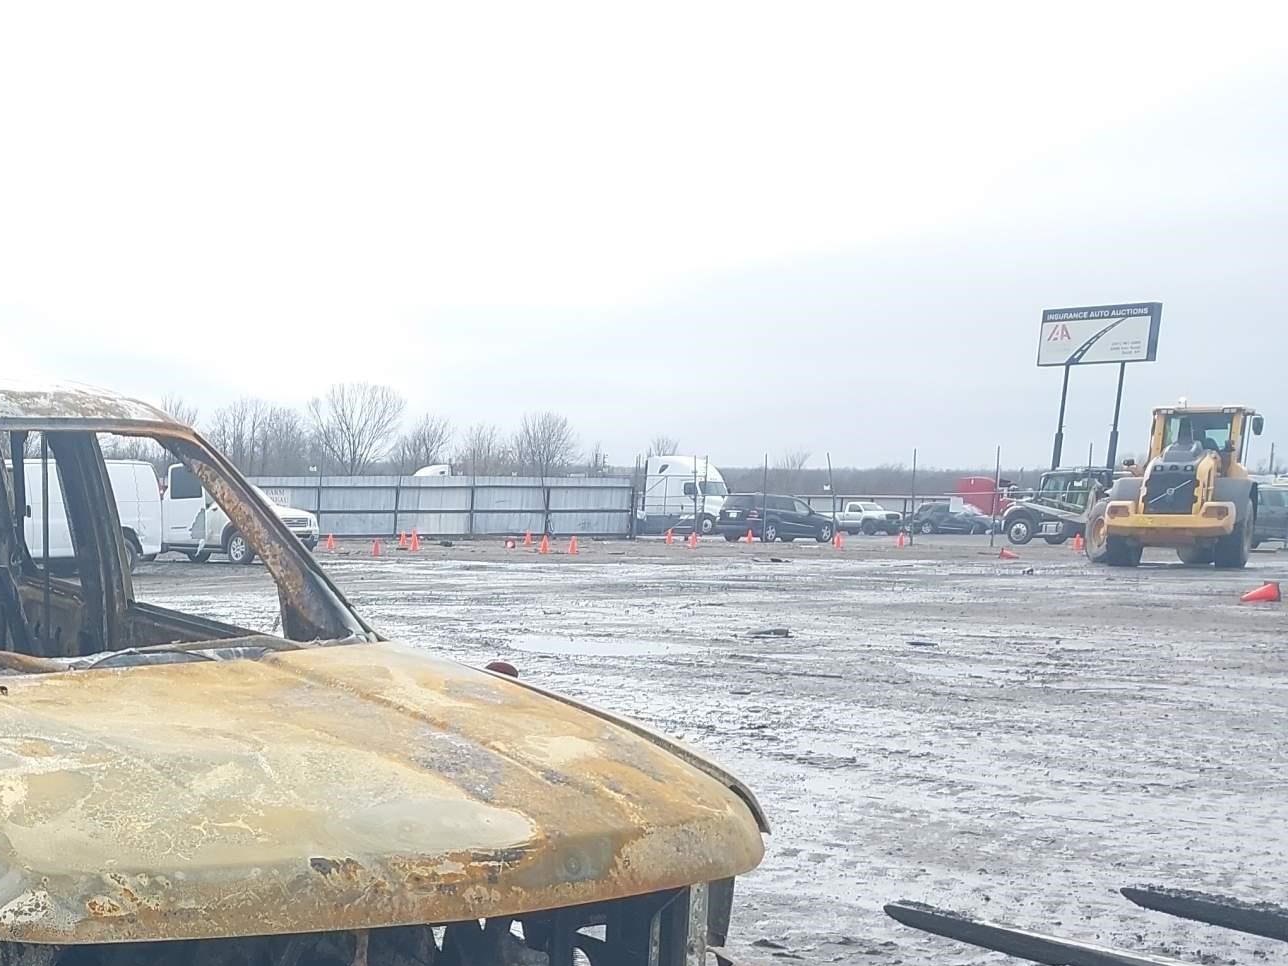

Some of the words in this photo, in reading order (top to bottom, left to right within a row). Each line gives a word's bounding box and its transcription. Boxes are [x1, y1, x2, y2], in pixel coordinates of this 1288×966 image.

[1047, 311, 1089, 321] INSURANCE
[1089, 309, 1110, 318] AUTO
[1111, 307, 1149, 317] AUCTIONS
